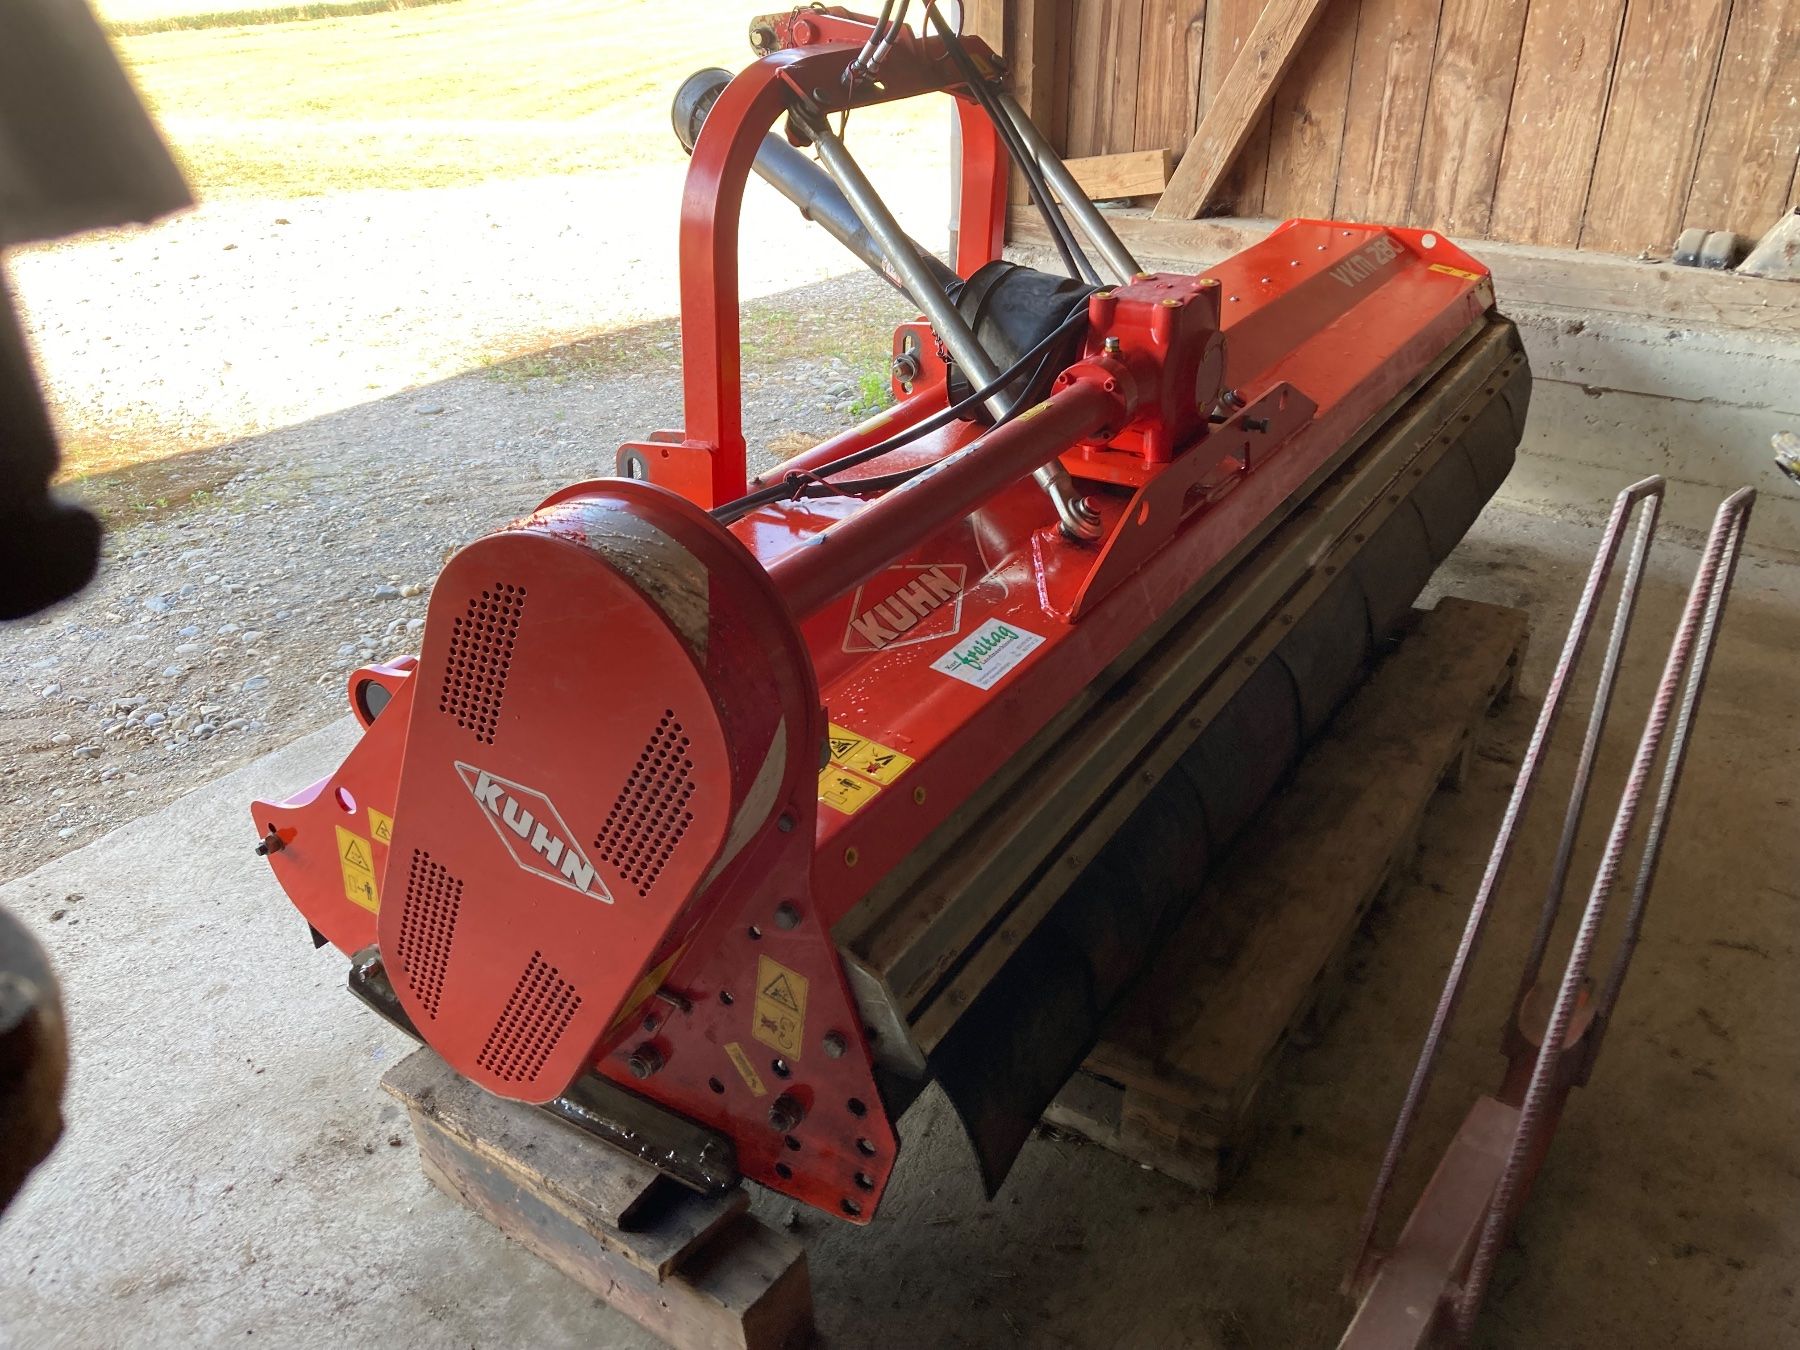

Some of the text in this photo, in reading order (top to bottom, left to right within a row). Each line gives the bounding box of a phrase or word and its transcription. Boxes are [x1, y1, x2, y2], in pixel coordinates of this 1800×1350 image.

[1328, 255, 1377, 288] VKM
[850, 565, 962, 649] KUHN
[473, 770, 595, 893] KUHN
